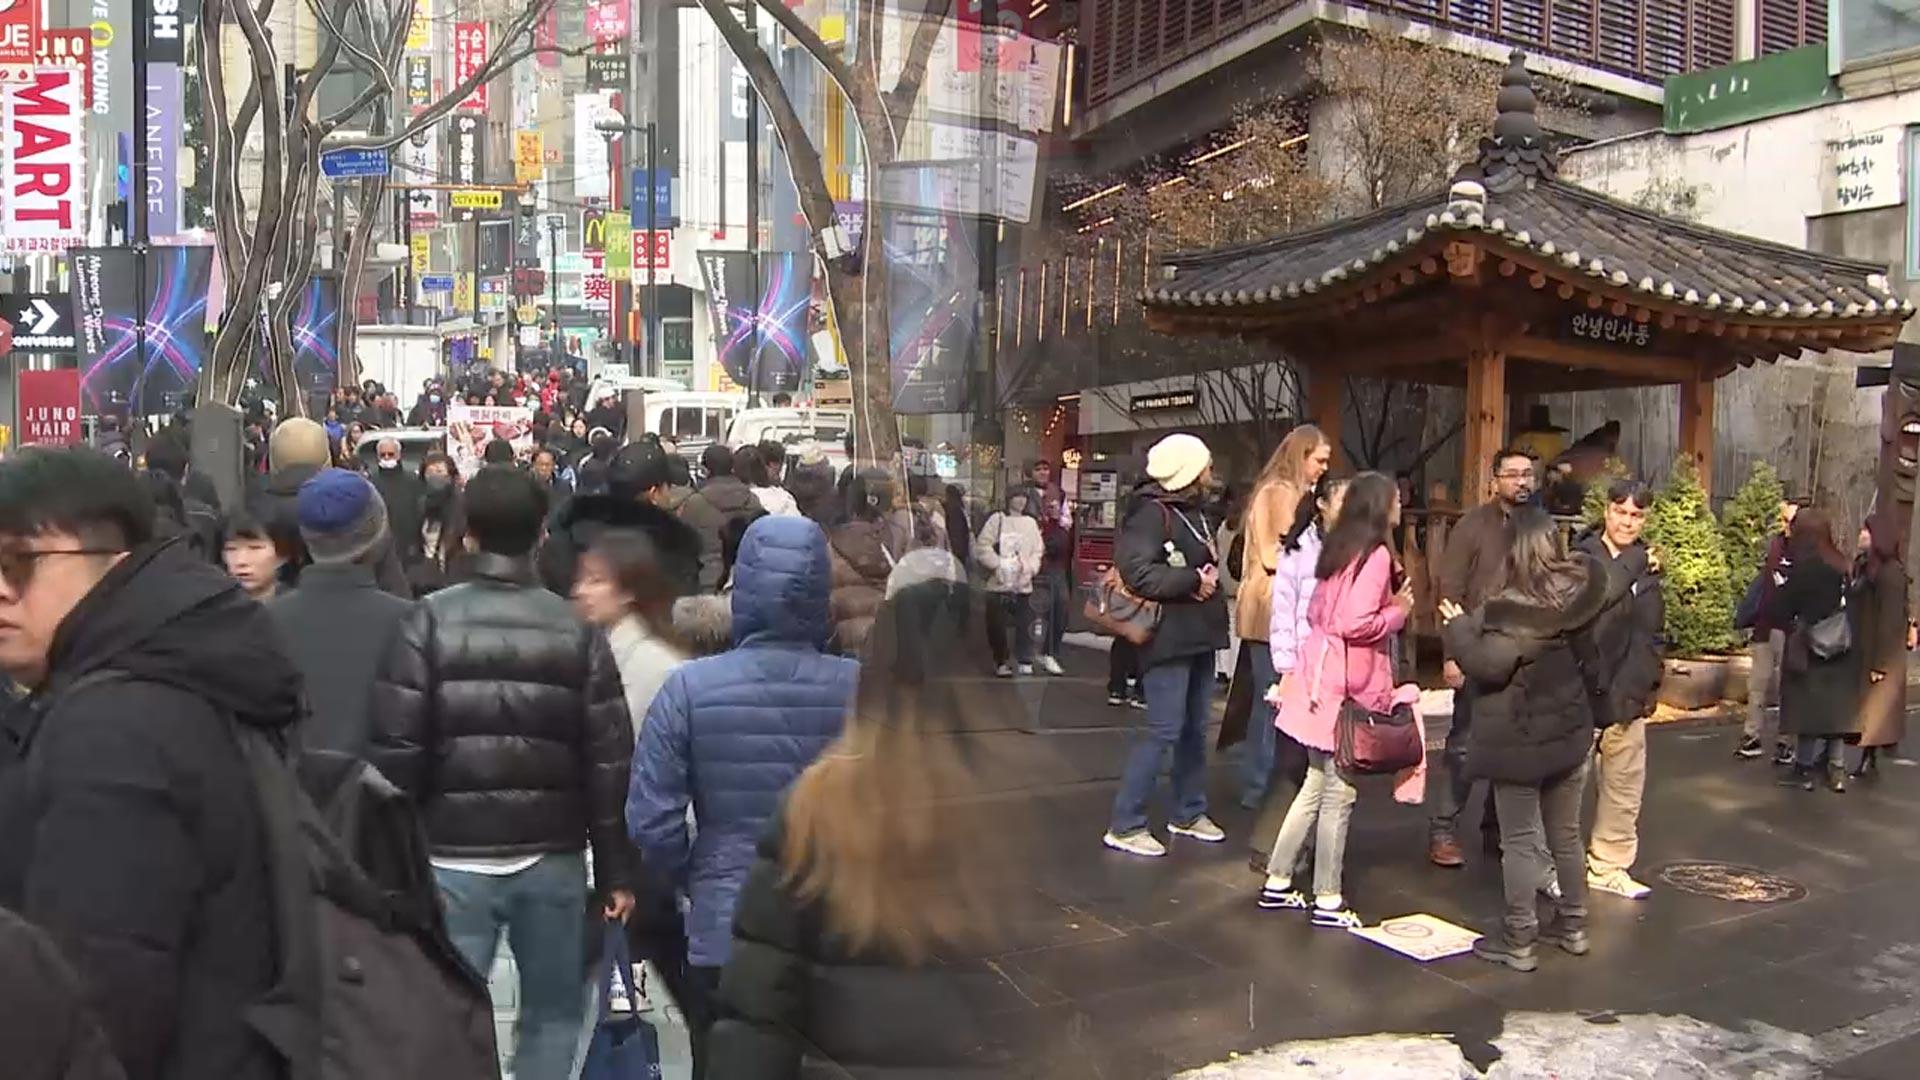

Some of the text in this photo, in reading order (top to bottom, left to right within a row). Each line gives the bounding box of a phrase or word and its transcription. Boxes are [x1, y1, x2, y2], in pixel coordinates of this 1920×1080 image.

[590, 60, 626, 69] Korea
[93, 49, 108, 114] YOUNG
[14, 72, 71, 229] MART
[84, 314, 96, 354] Waves
[1572, 313, 1650, 346] 안녕인사동
[26, 407, 76, 421] JUNO
[31, 422, 71, 436] HAIR
